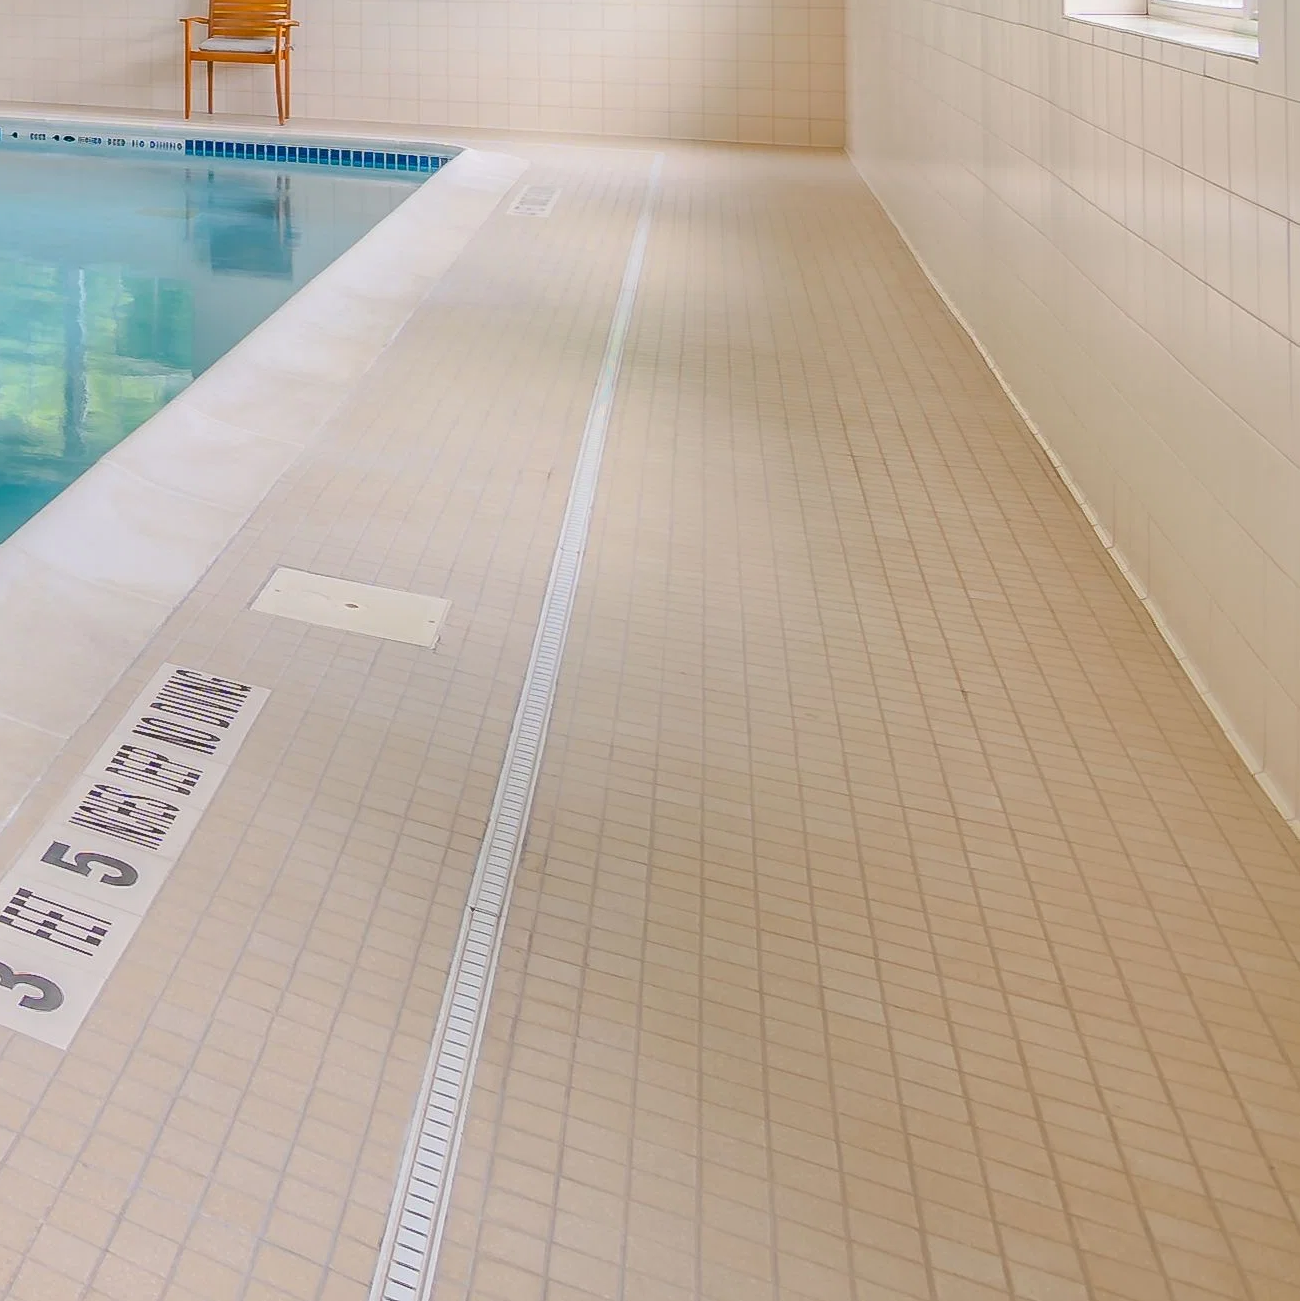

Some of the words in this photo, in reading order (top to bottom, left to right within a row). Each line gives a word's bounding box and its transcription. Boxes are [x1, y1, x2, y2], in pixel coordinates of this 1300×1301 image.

[149, 668, 252, 729] DIVING
[132, 716, 221, 755] NO
[105, 744, 204, 796] DEEP
[69, 784, 181, 851] INCHES
[40, 840, 139, 888] 5
